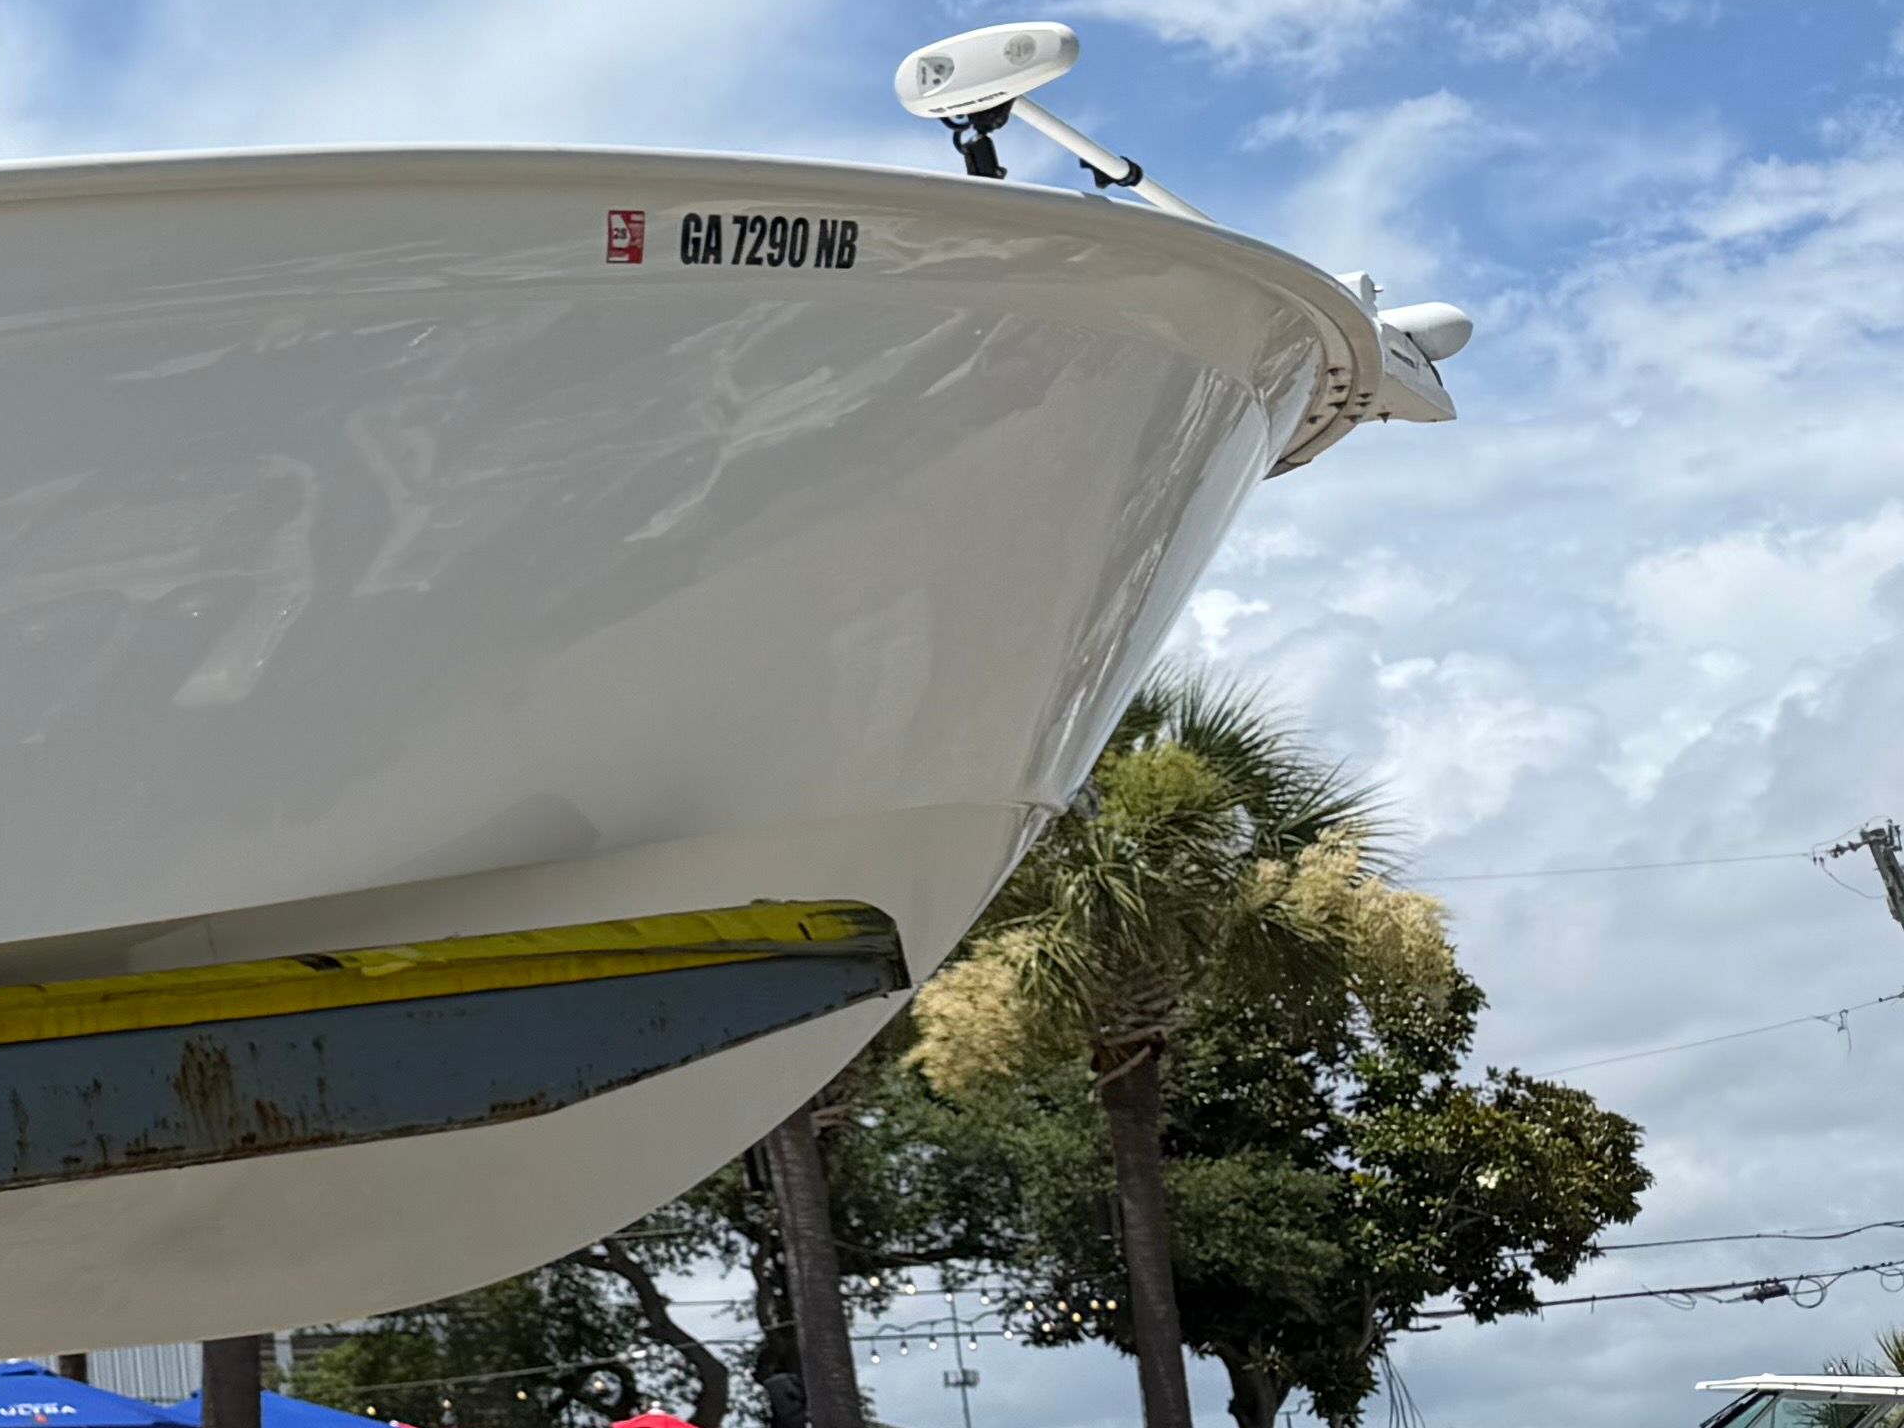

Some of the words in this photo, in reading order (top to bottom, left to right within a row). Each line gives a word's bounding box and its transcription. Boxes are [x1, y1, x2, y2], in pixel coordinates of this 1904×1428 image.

[680, 213, 723, 266] GA
[730, 215, 809, 268] 7290
[813, 219, 859, 270] NB
